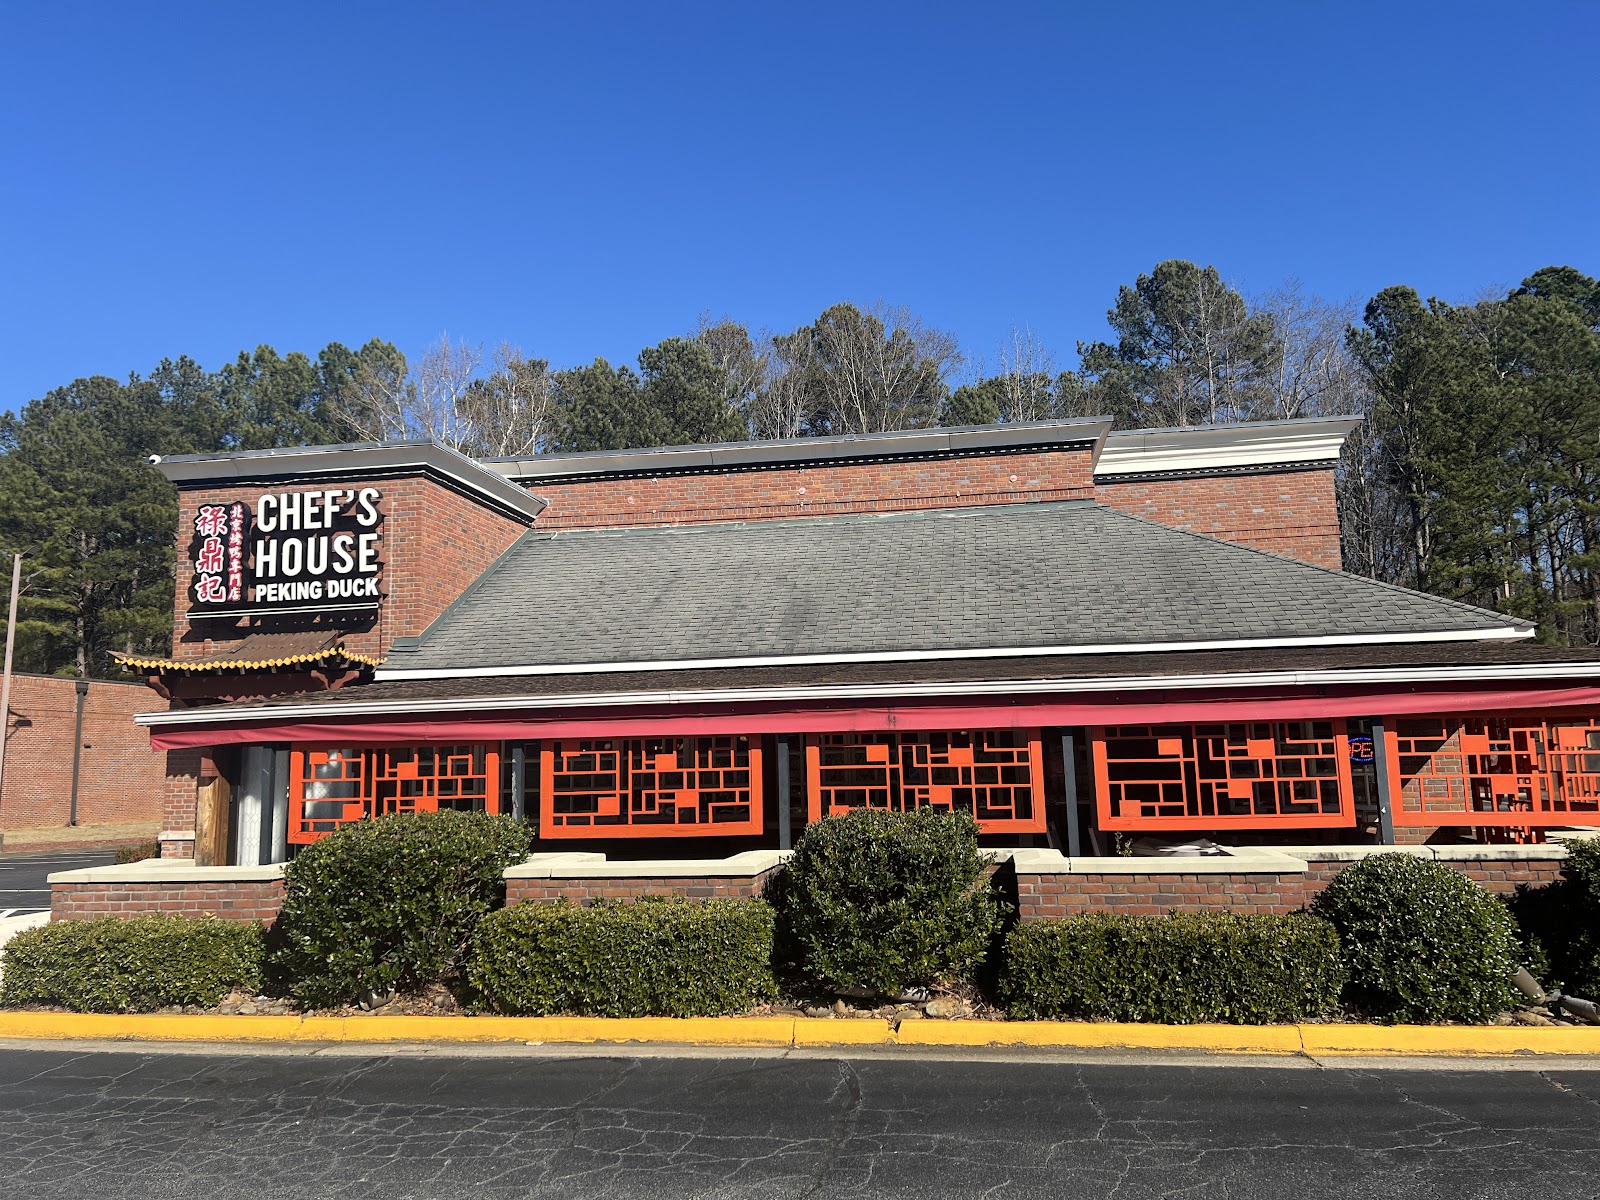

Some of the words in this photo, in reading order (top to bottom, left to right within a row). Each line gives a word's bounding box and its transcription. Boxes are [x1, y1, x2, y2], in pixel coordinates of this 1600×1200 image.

[257, 487, 380, 533] CHEF'S
[255, 533, 379, 578] HOUSE
[255, 580, 323, 603] PEKING
[325, 577, 379, 597] DUCK
